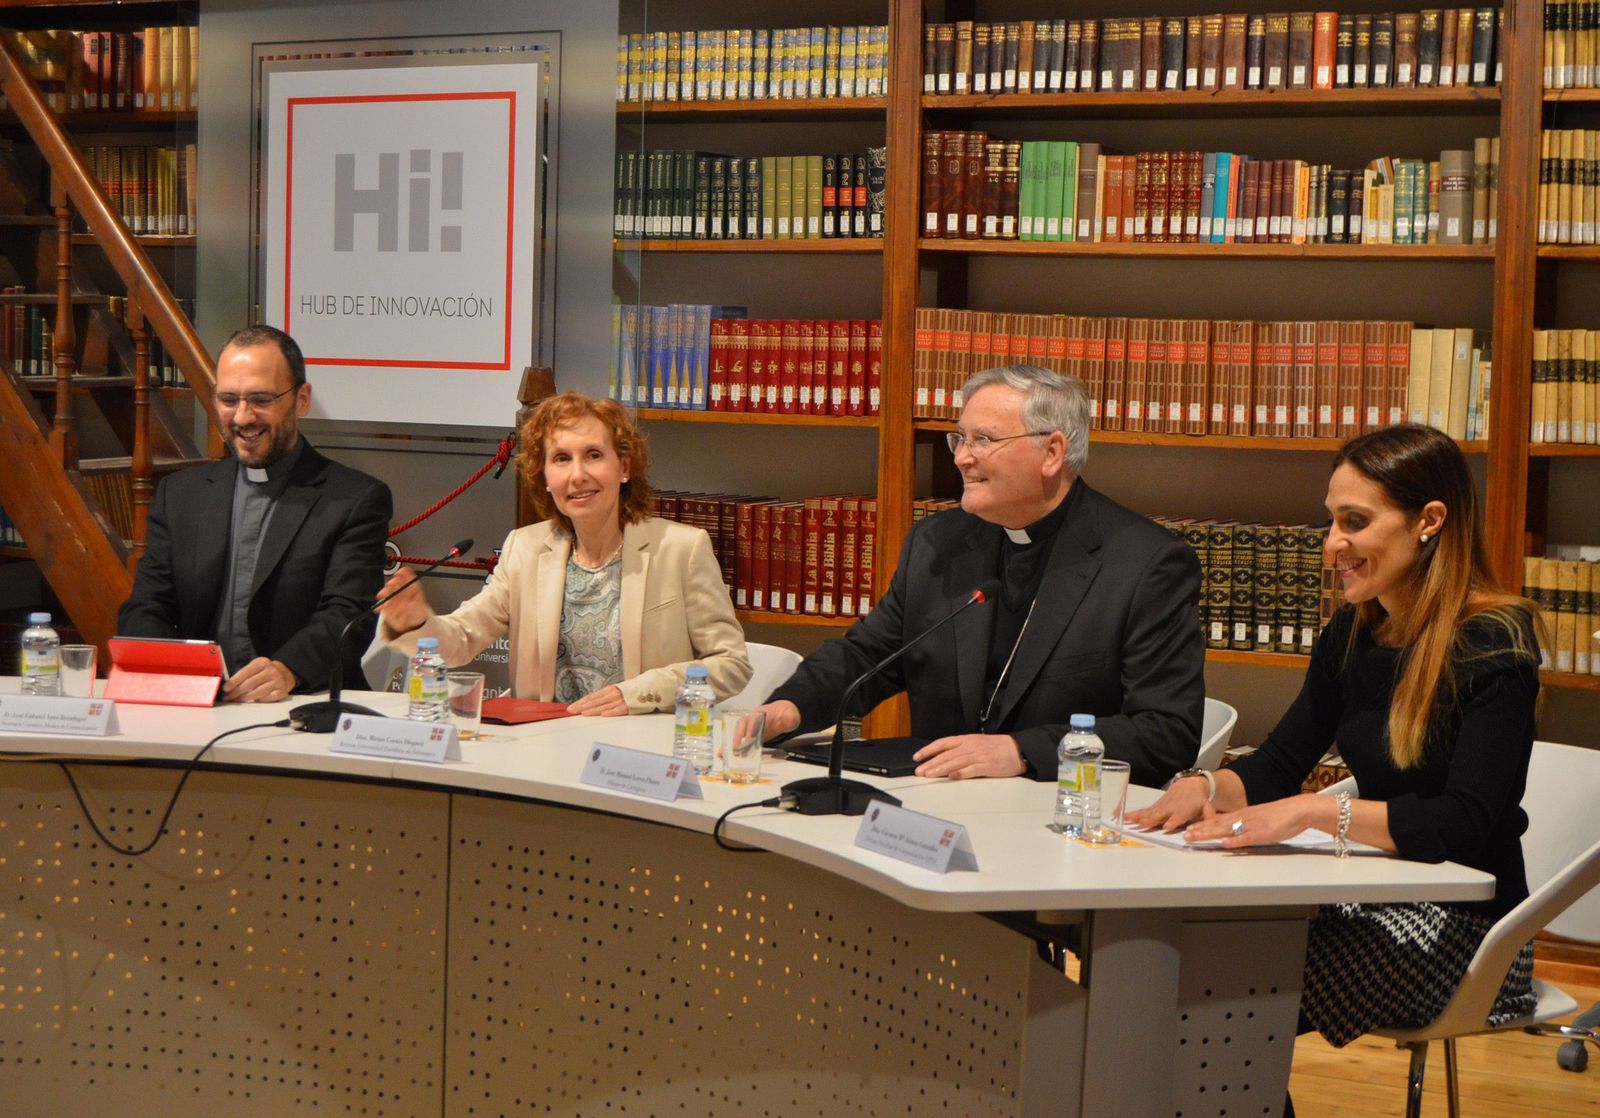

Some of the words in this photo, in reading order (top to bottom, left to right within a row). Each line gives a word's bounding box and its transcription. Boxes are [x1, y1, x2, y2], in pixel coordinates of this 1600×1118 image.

[826, 173, 832, 186] 1
[841, 173, 849, 186] 2
[856, 172, 864, 186] 3
[334, 149, 463, 252] Hi!
[300, 295, 337, 316] HUB
[343, 295, 365, 316] DE
[370, 292, 493, 318] INNOVACIÓN
[805, 531, 818, 567] Biblia
[823, 532, 835, 568] Biblia
[843, 533, 855, 569] Biblia
[861, 534, 874, 569] Biblia
[805, 569, 817, 586] La
[823, 570, 834, 588] La
[843, 571, 854, 589] La
[860, 572, 872, 589] La
